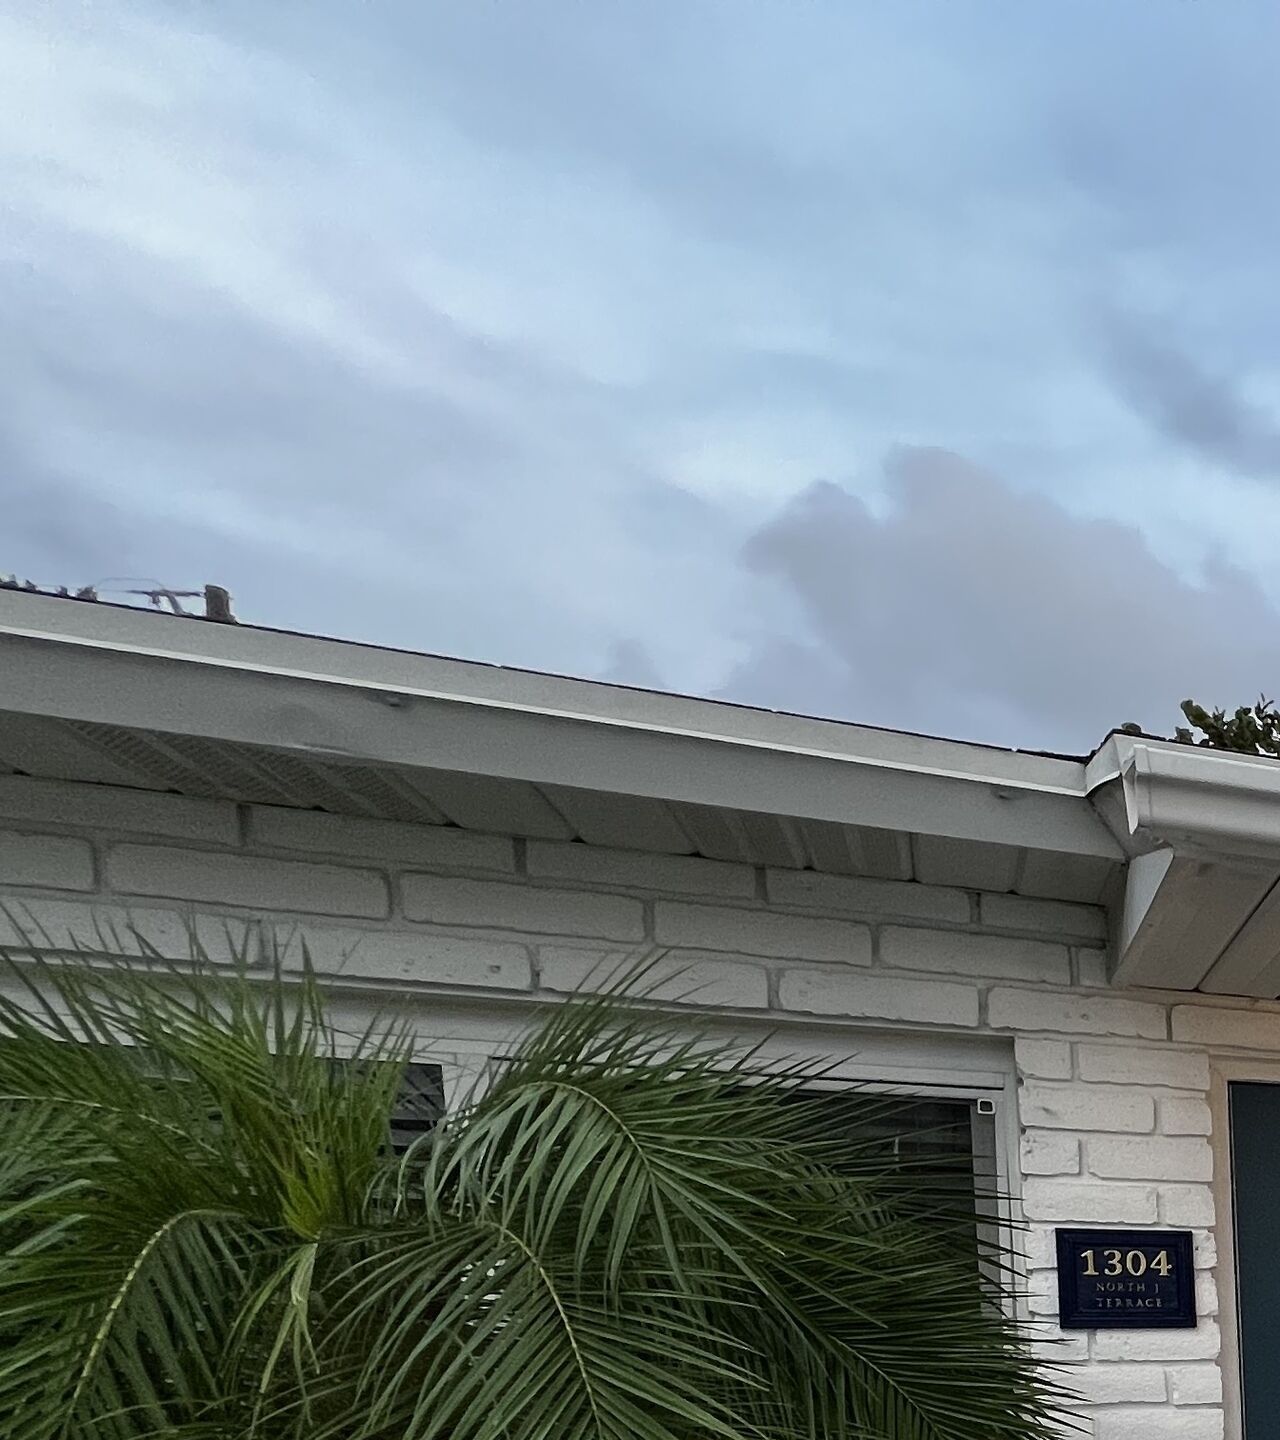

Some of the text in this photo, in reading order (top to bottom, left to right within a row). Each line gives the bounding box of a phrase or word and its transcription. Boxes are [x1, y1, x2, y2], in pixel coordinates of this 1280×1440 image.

[1080, 1249, 1172, 1276] 1304
[1096, 1282, 1146, 1292] NORTH
[1095, 1298, 1162, 1308] TERRACE
